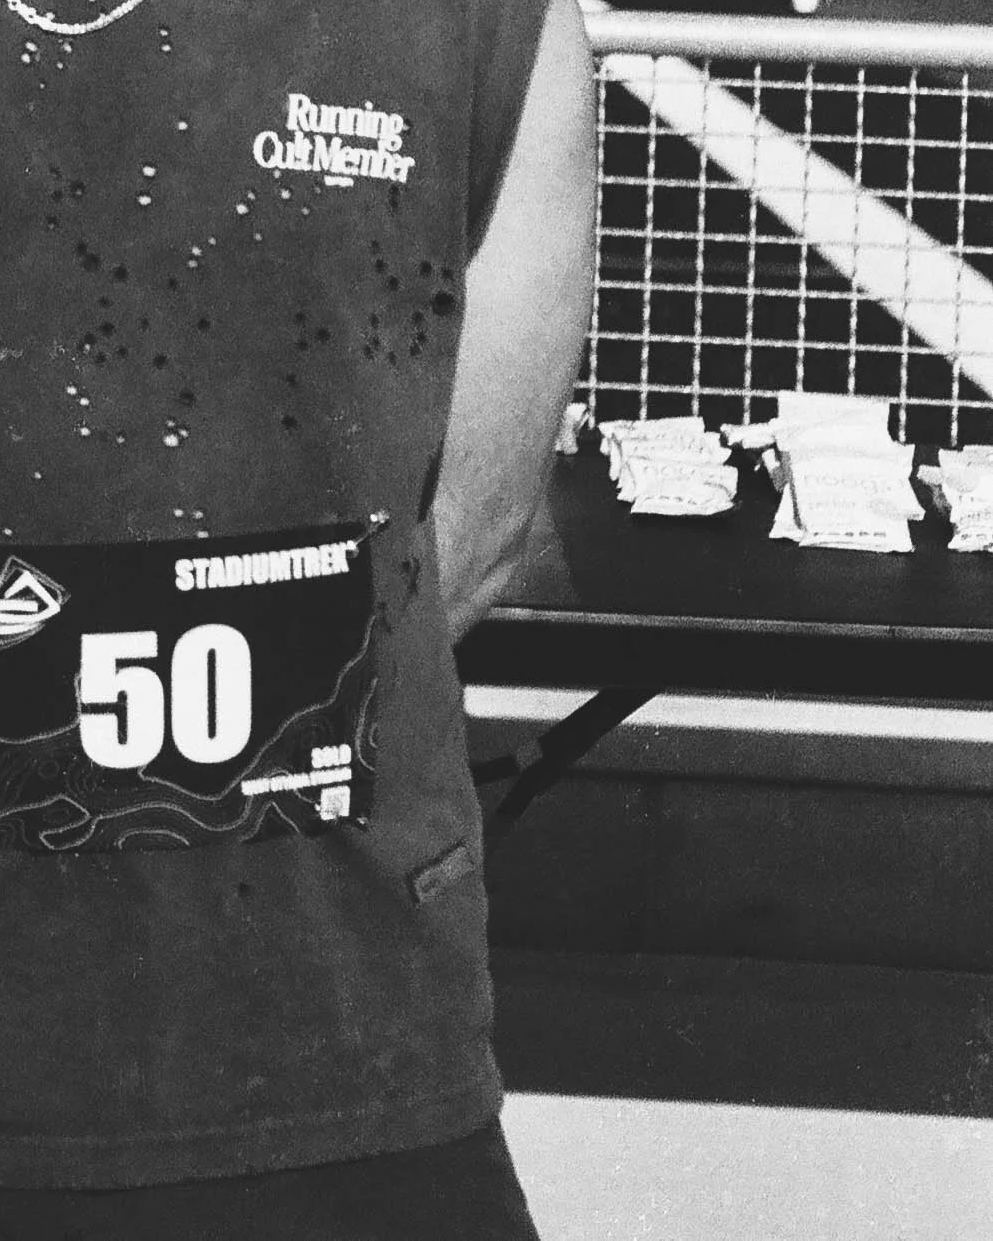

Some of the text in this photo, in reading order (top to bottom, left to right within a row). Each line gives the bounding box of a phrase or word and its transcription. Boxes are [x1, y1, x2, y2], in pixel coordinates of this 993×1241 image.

[287, 93, 404, 151] Running
[253, 130, 415, 183] Cult Member
[175, 542, 354, 591] STADIUMTREK
[79, 623, 252, 769] 50
